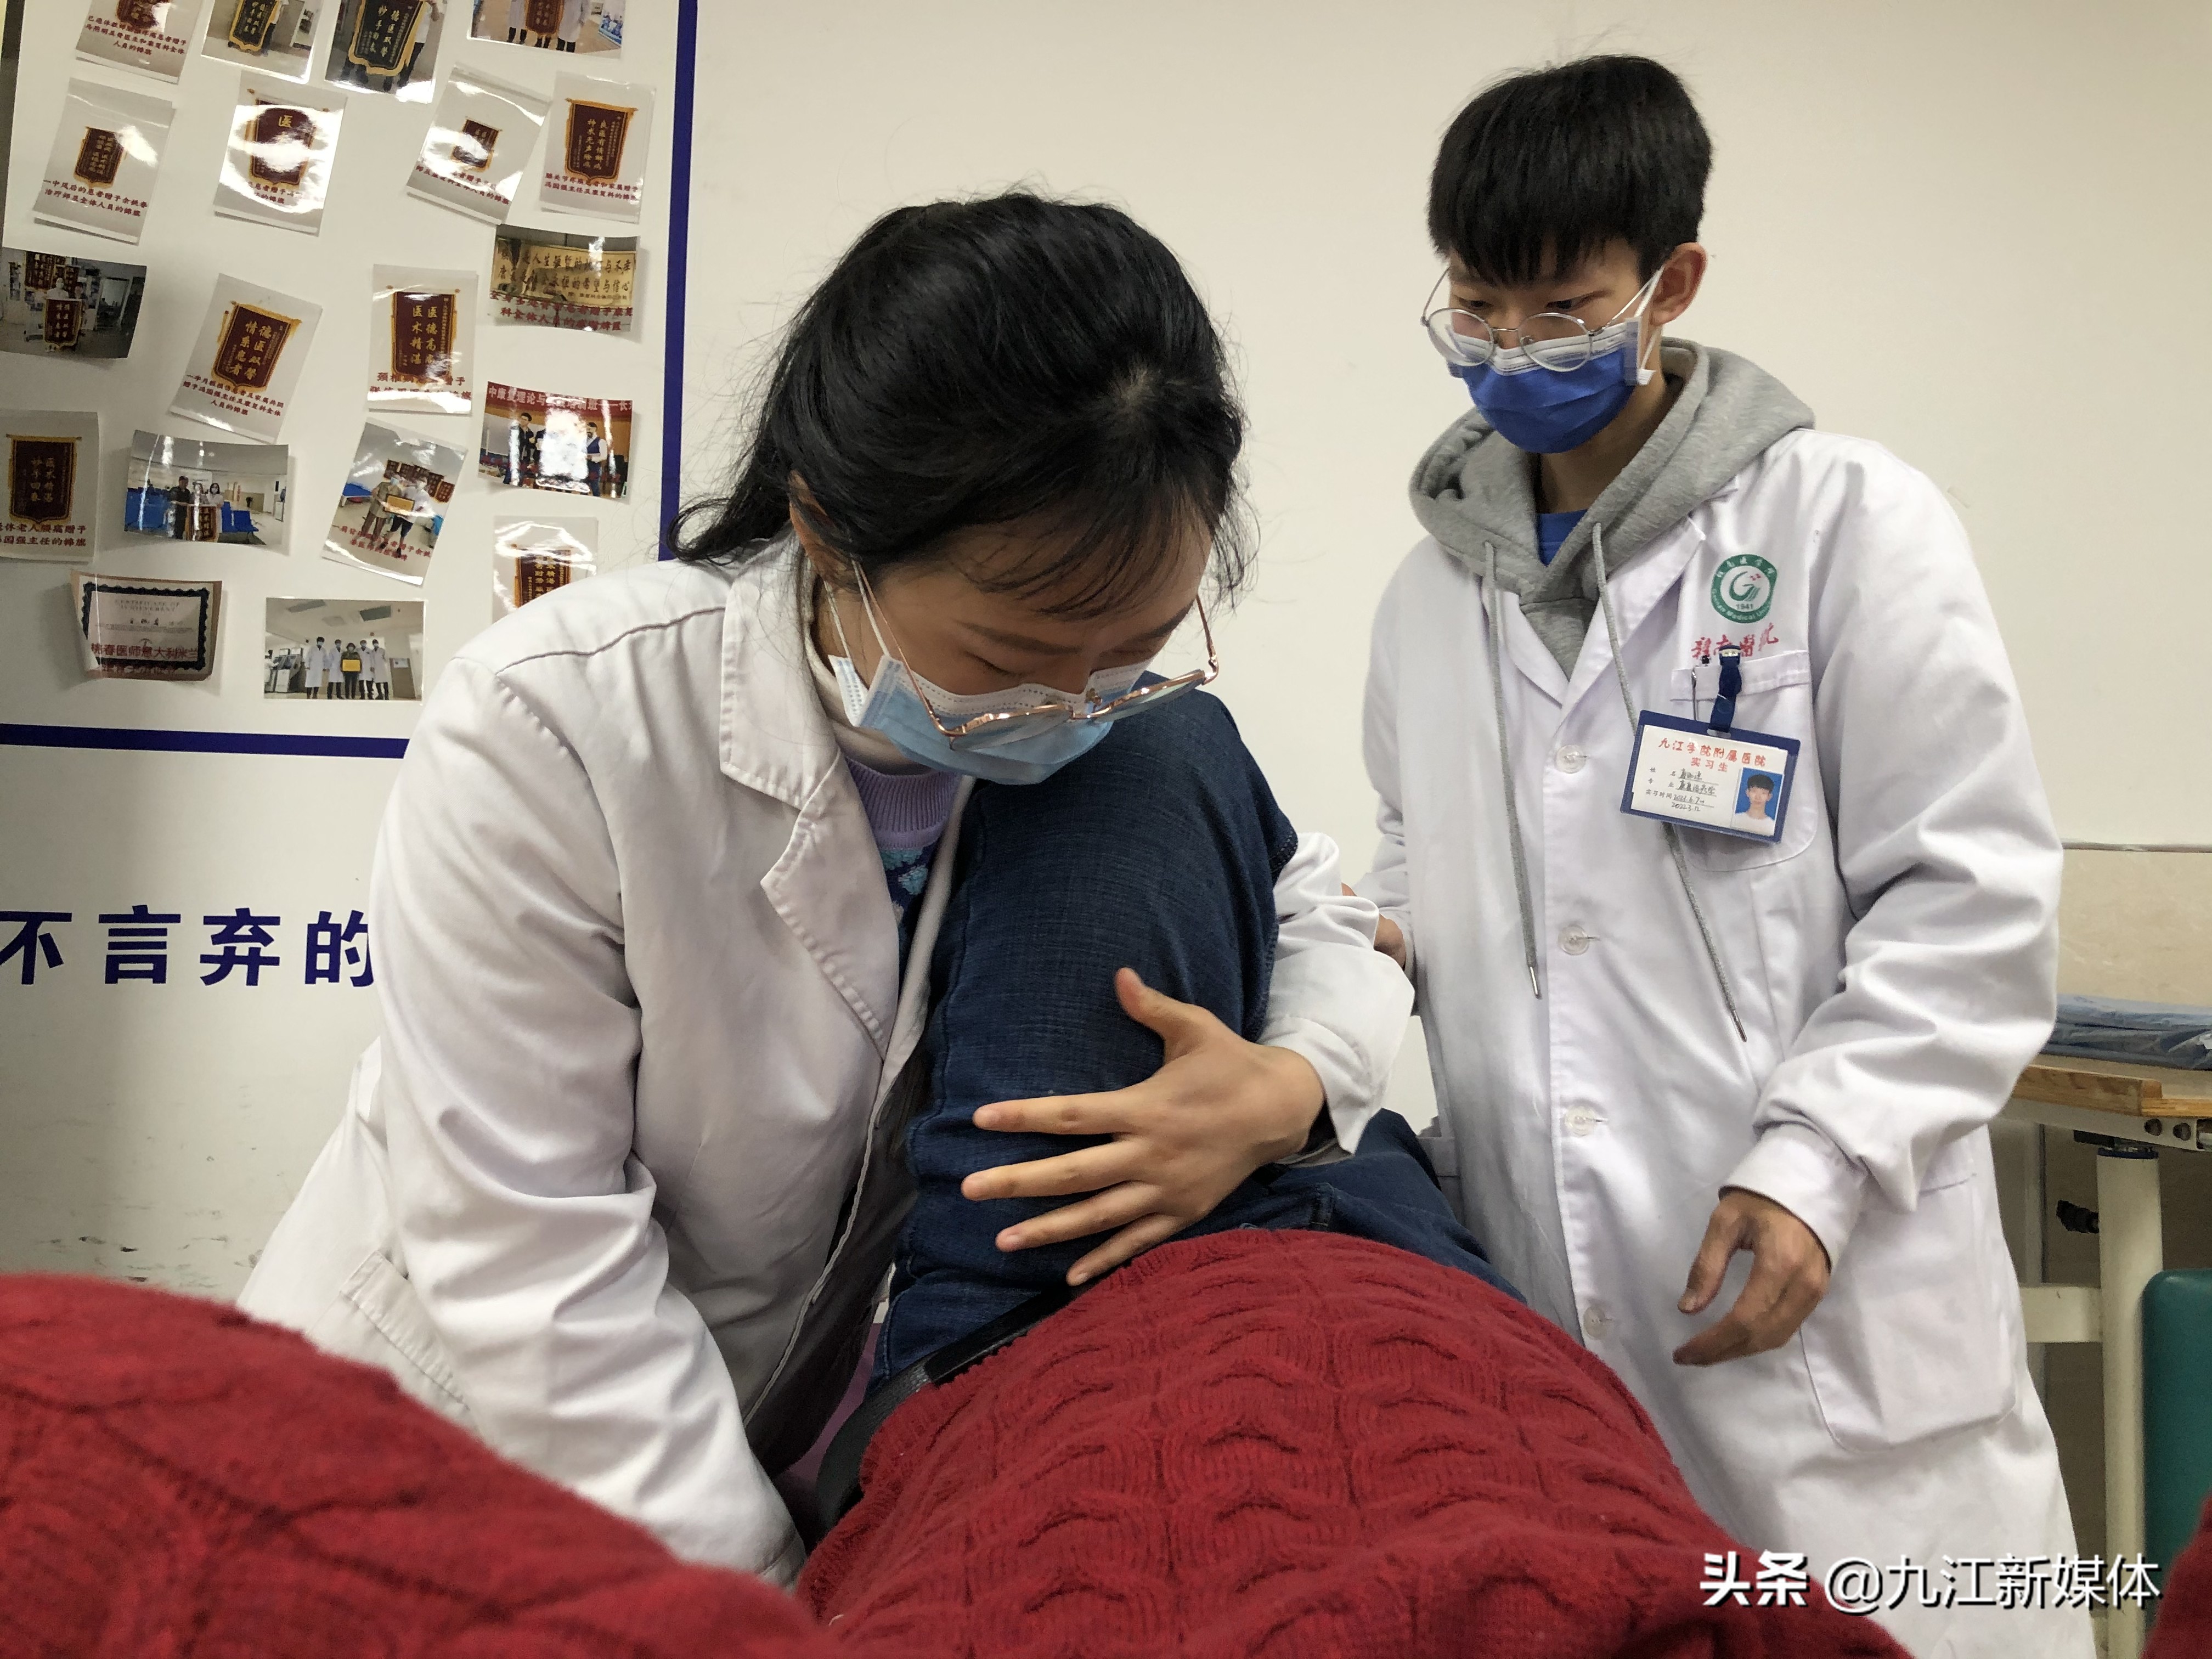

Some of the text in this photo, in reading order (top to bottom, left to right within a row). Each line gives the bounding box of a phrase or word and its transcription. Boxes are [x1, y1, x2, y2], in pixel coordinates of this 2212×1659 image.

[278, 115, 292, 128] 医
[410, 305, 422, 364] 医术精湛
[1658, 737, 1767, 767] 九江学院附属医院
[1691, 757, 1728, 772] 实习生
[0, 905, 374, 988] 不言弃的
